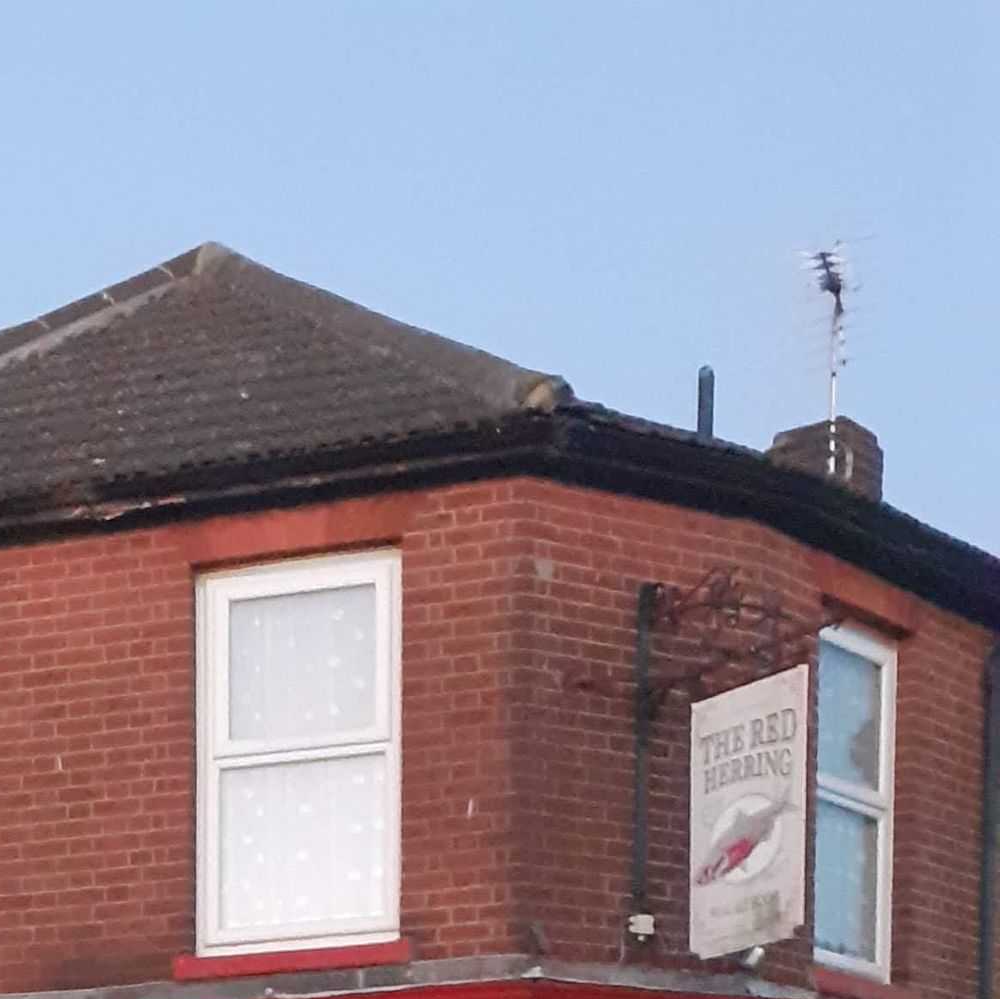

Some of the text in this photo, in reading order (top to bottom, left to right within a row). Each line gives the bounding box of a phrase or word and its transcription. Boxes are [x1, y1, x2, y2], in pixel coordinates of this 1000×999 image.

[700, 707, 798, 765] THE RED
[704, 747, 792, 795] HERRING
